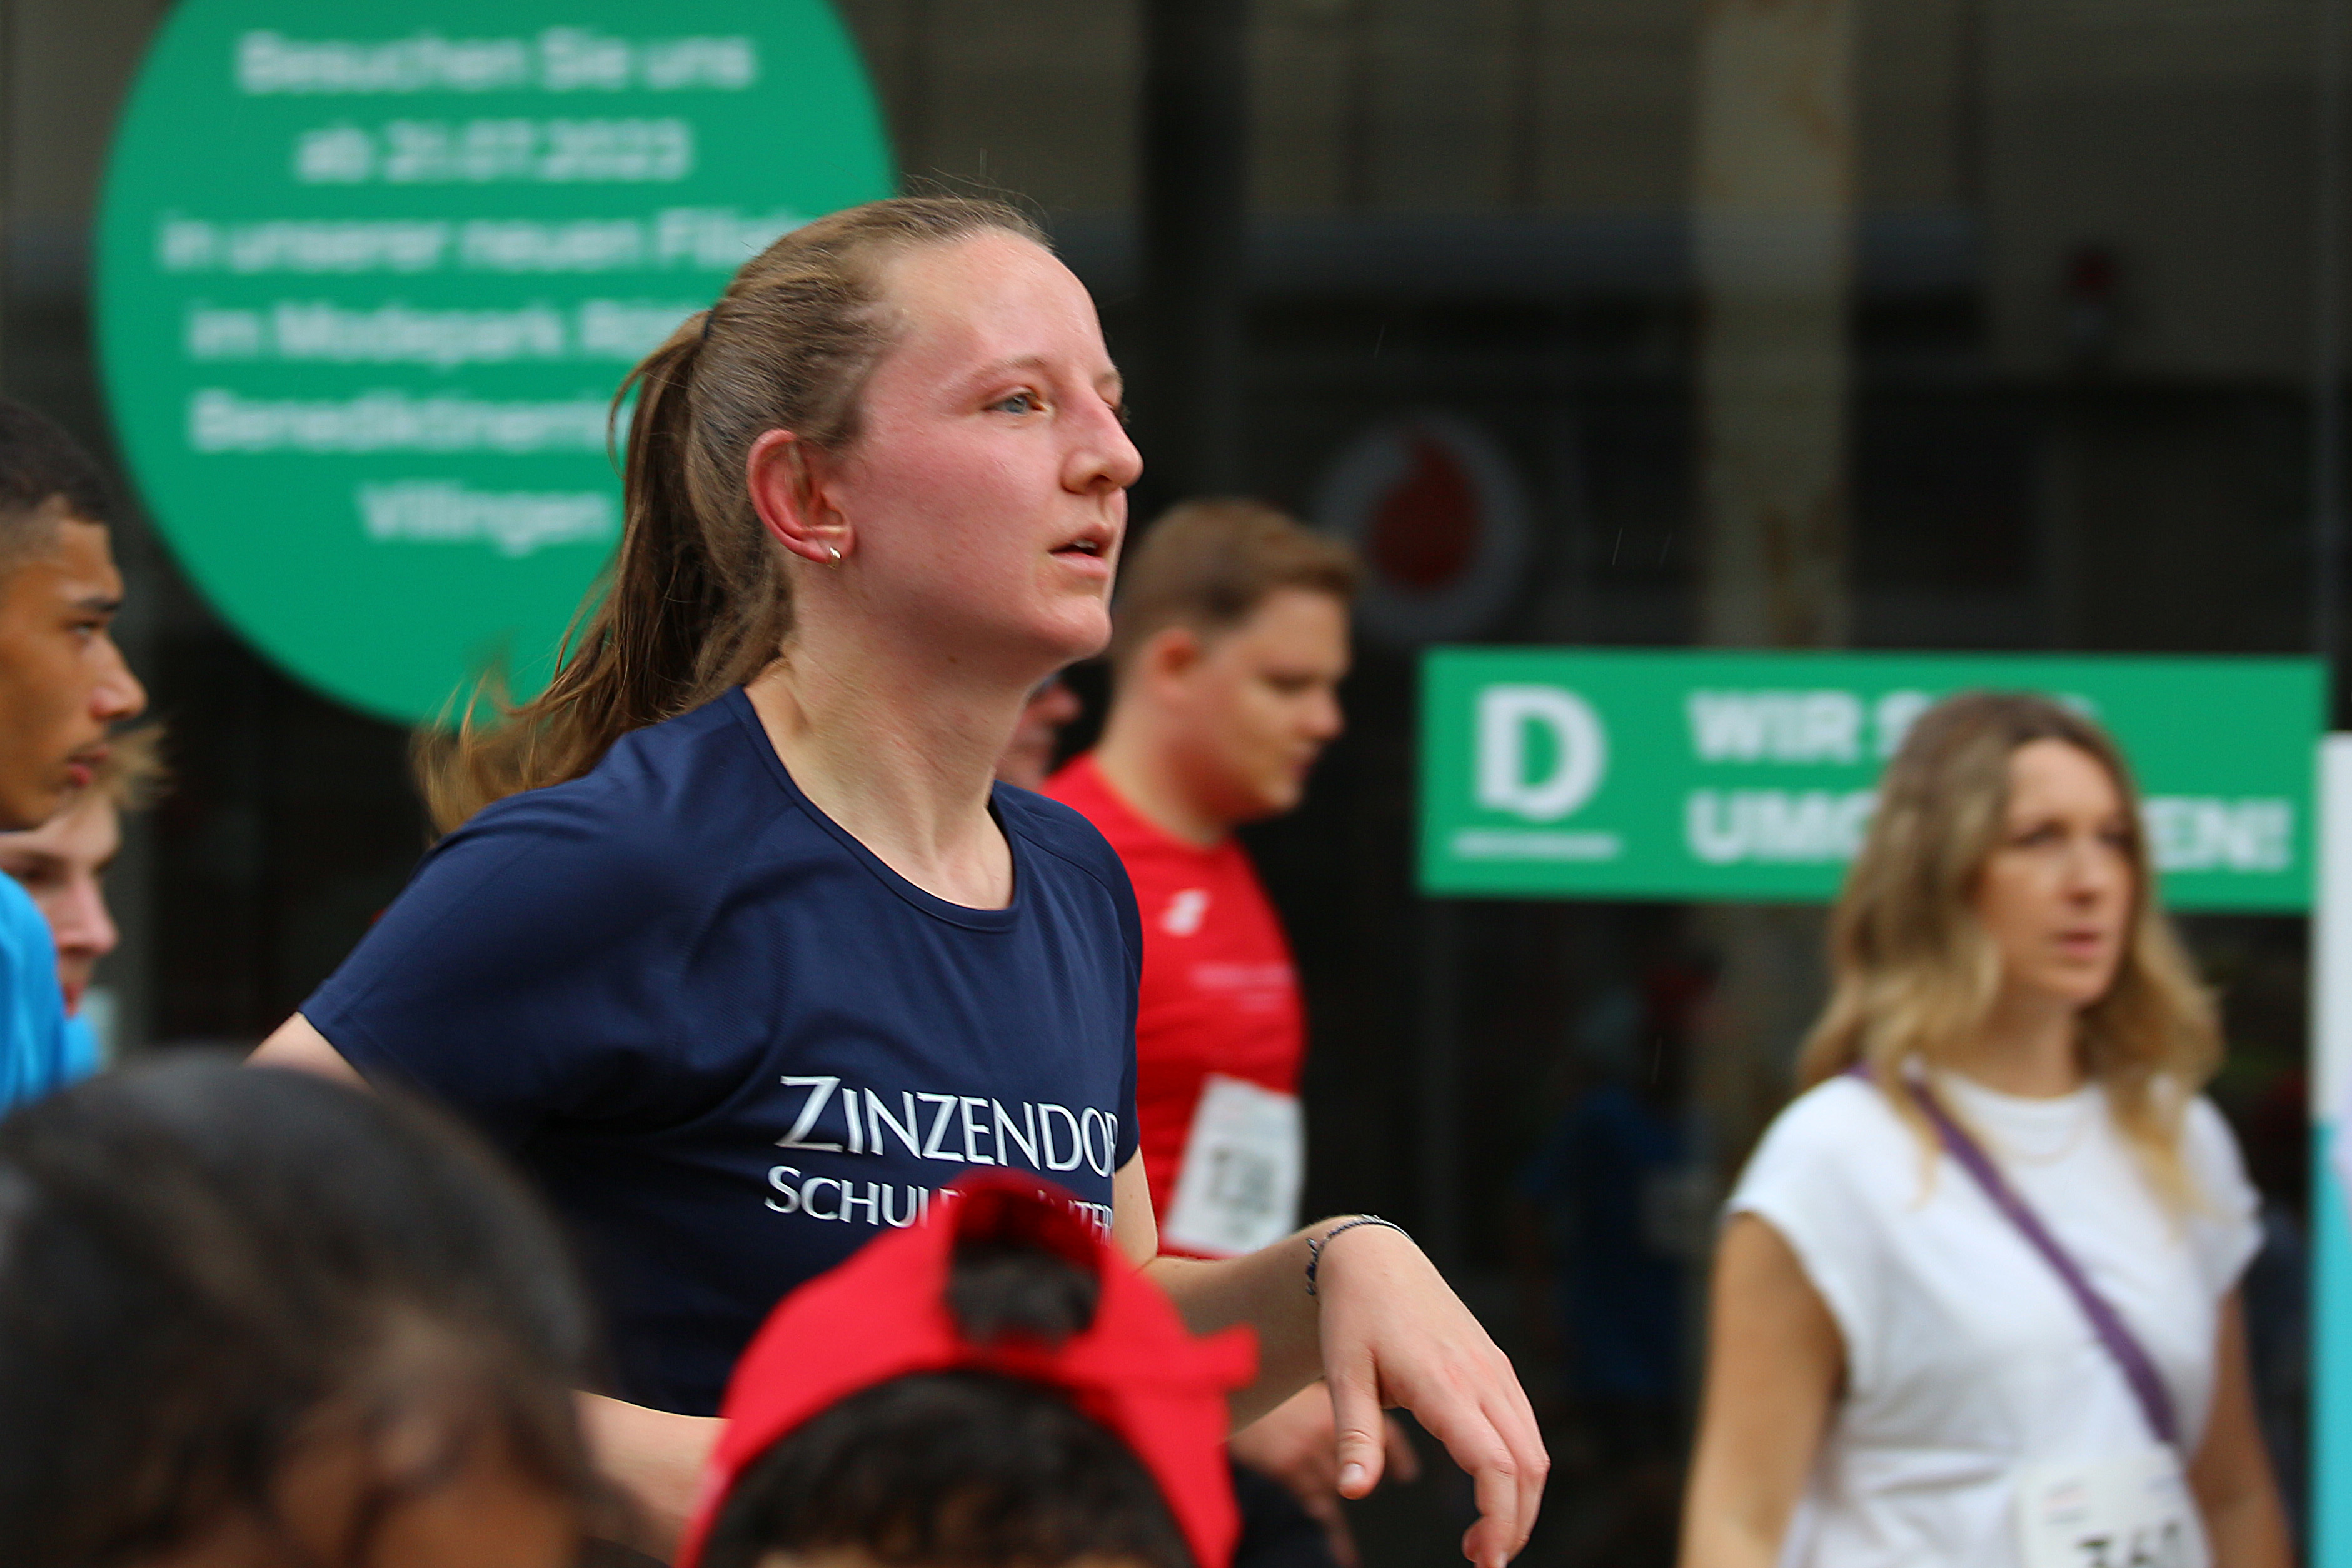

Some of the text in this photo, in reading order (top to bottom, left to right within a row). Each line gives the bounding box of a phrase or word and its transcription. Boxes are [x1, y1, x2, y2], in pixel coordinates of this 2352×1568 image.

[238, 28, 755, 93] Besuchen Sie uns
[296, 125, 376, 183] ab
[159, 211, 220, 272] in
[224, 220, 451, 273] unserer
[459, 220, 648, 271] neuen
[188, 303, 264, 356] im
[270, 303, 568, 370] Modepark
[360, 480, 616, 556] Villingen
[1473, 683, 1610, 822] D
[1686, 690, 1866, 764] WIR
